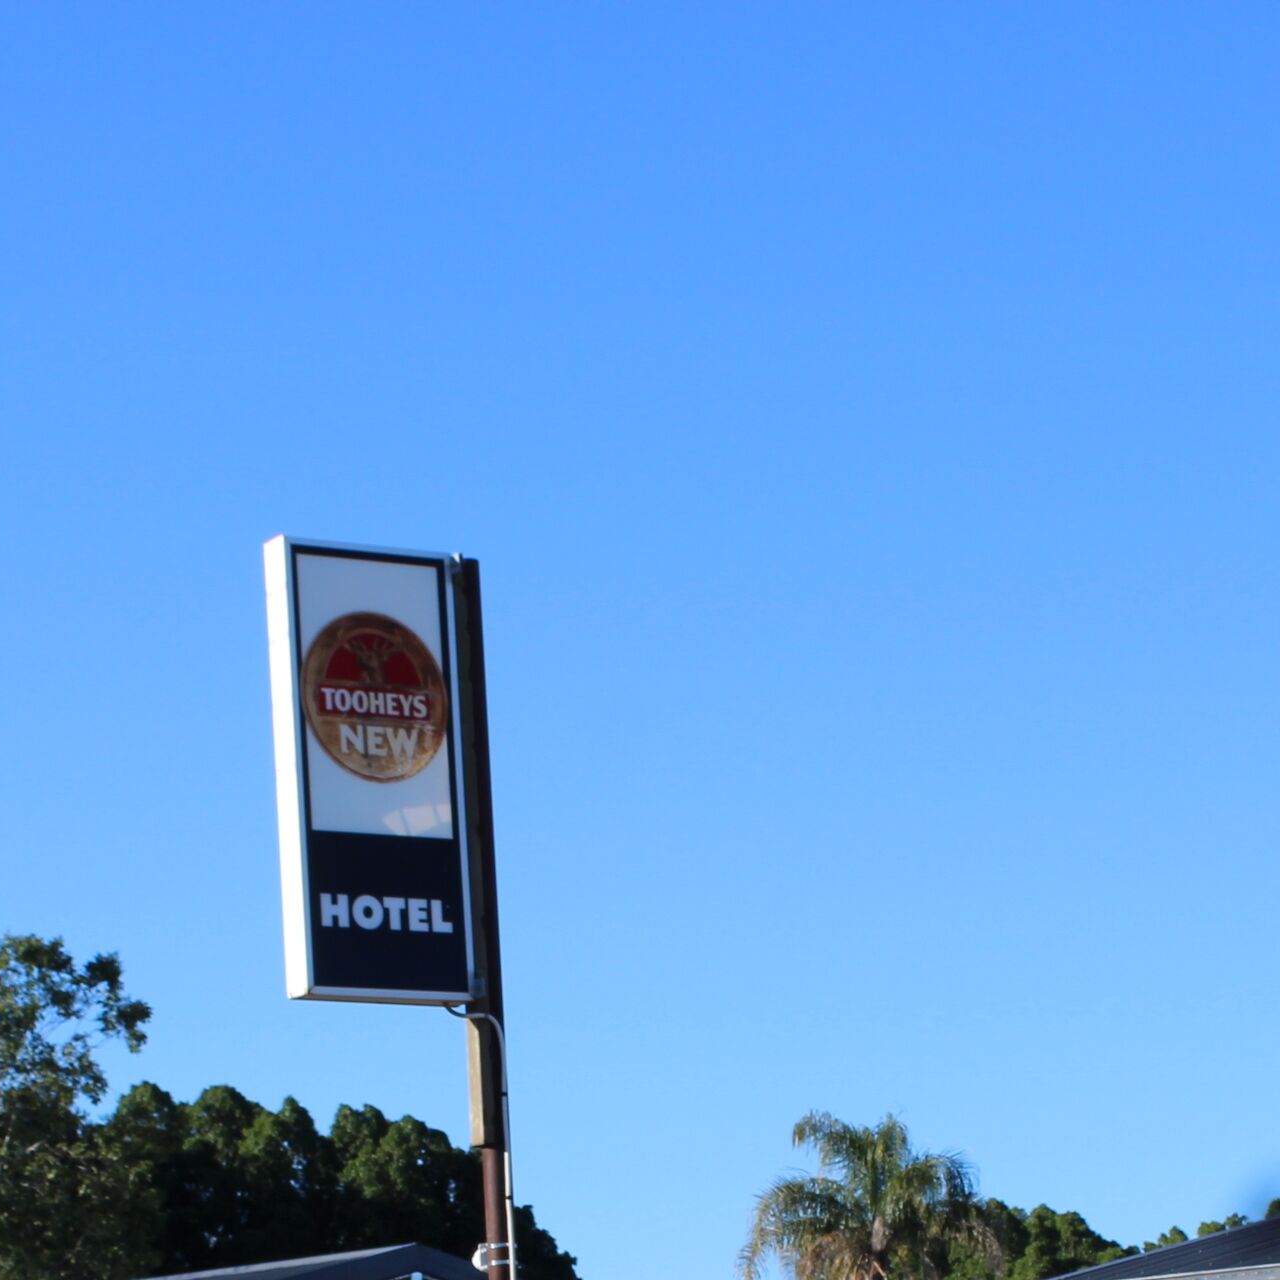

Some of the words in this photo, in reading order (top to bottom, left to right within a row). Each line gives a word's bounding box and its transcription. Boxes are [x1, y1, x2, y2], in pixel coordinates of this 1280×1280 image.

[321, 687, 428, 718] TOOHEYS
[339, 723, 419, 760] NEW
[320, 893, 454, 934] HOTEL
